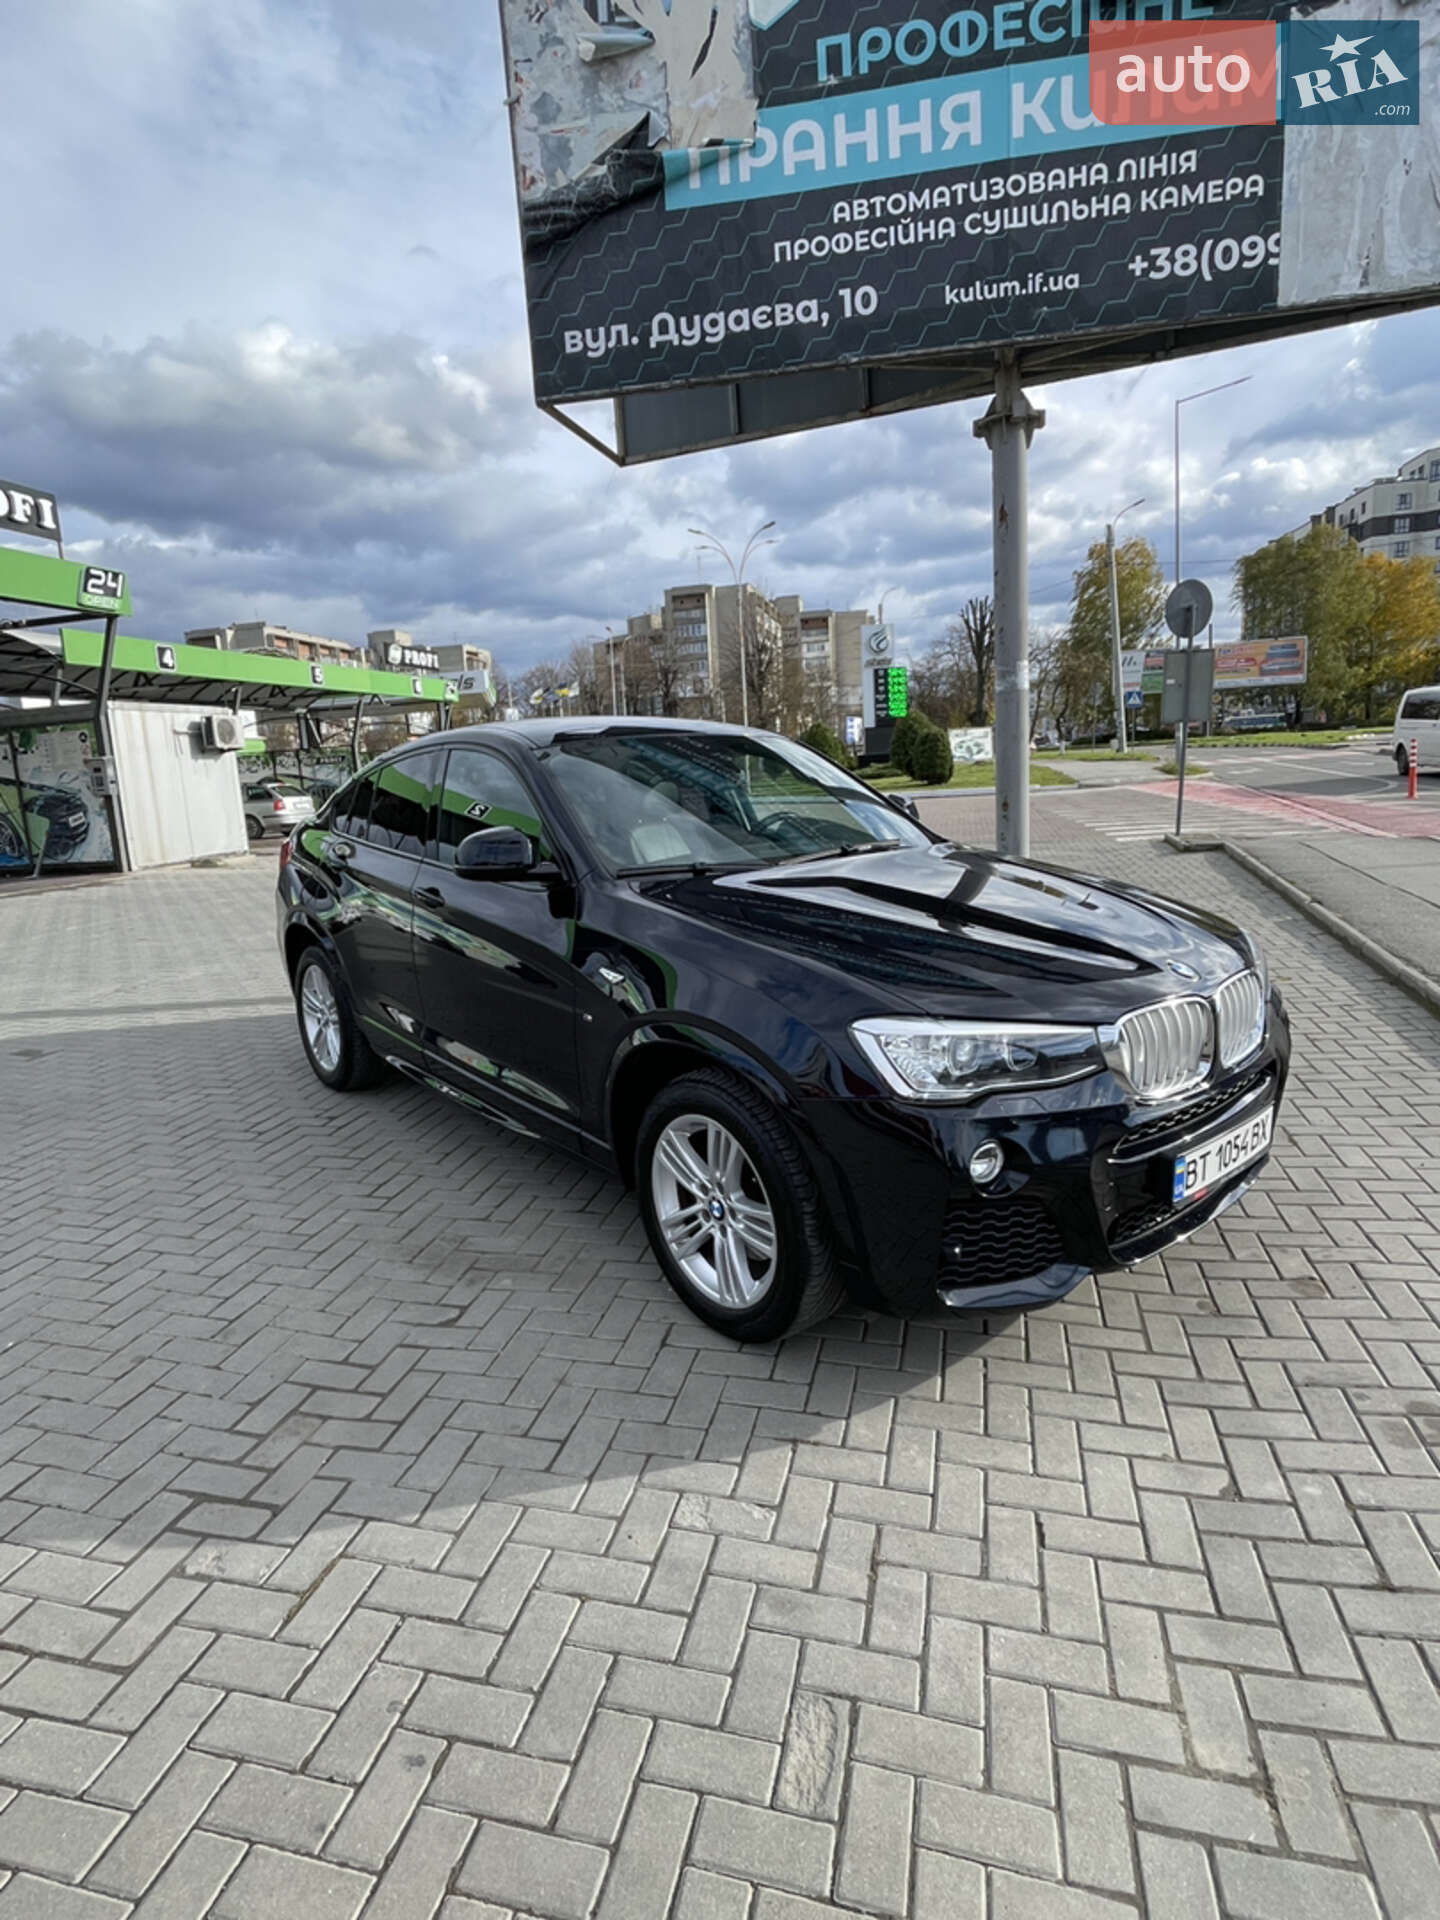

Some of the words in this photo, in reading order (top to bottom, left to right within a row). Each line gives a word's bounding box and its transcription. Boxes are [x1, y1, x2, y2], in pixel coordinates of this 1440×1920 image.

[688, 90, 983, 190] ПРАННЯ
[773, 217, 956, 263] ПРОФЕСІЙНА
[963, 193, 1131, 235] СУШИЛЬНА
[1141, 173, 1265, 212] КАМЕРА
[832, 162, 1108, 223] АВТОМАТИЗОВАНА
[1116, 150, 1197, 182] ЛІНІЯ
[563, 323, 639, 358] вул.
[649, 298, 829, 348] Дудаєва,
[838, 285, 878, 318] 10
[944, 271, 1080, 306] kulum.if.ua
[87, 568, 123, 597] 24
[162, 649, 173, 668] 4
[313, 667, 322, 684] 5
[1185, 1151, 1211, 1190] BT
[1216, 1129, 1249, 1172] 1054
[1250, 1114, 1270, 1151] BX
